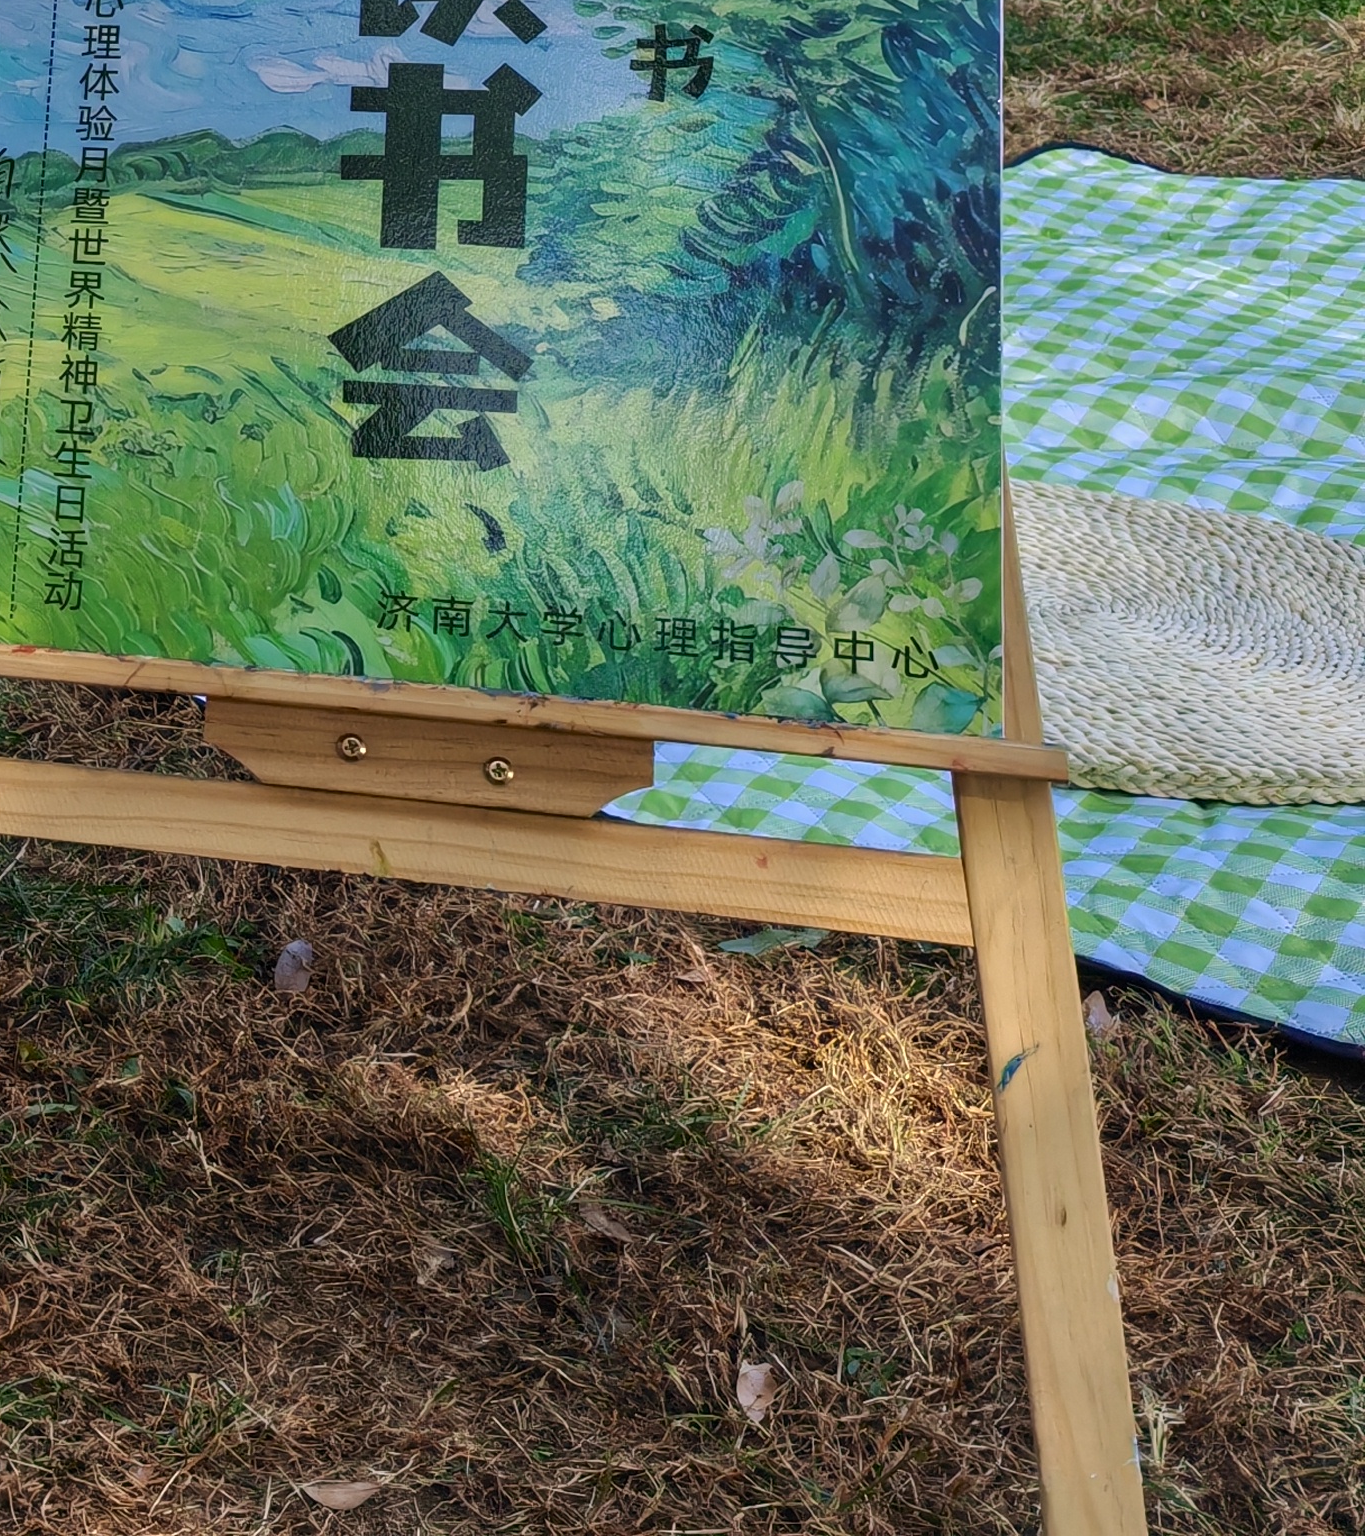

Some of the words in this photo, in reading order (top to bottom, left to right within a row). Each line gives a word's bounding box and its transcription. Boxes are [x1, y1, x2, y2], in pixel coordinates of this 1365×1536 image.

[376, 591, 940, 680] 济南大学心理指导中心
